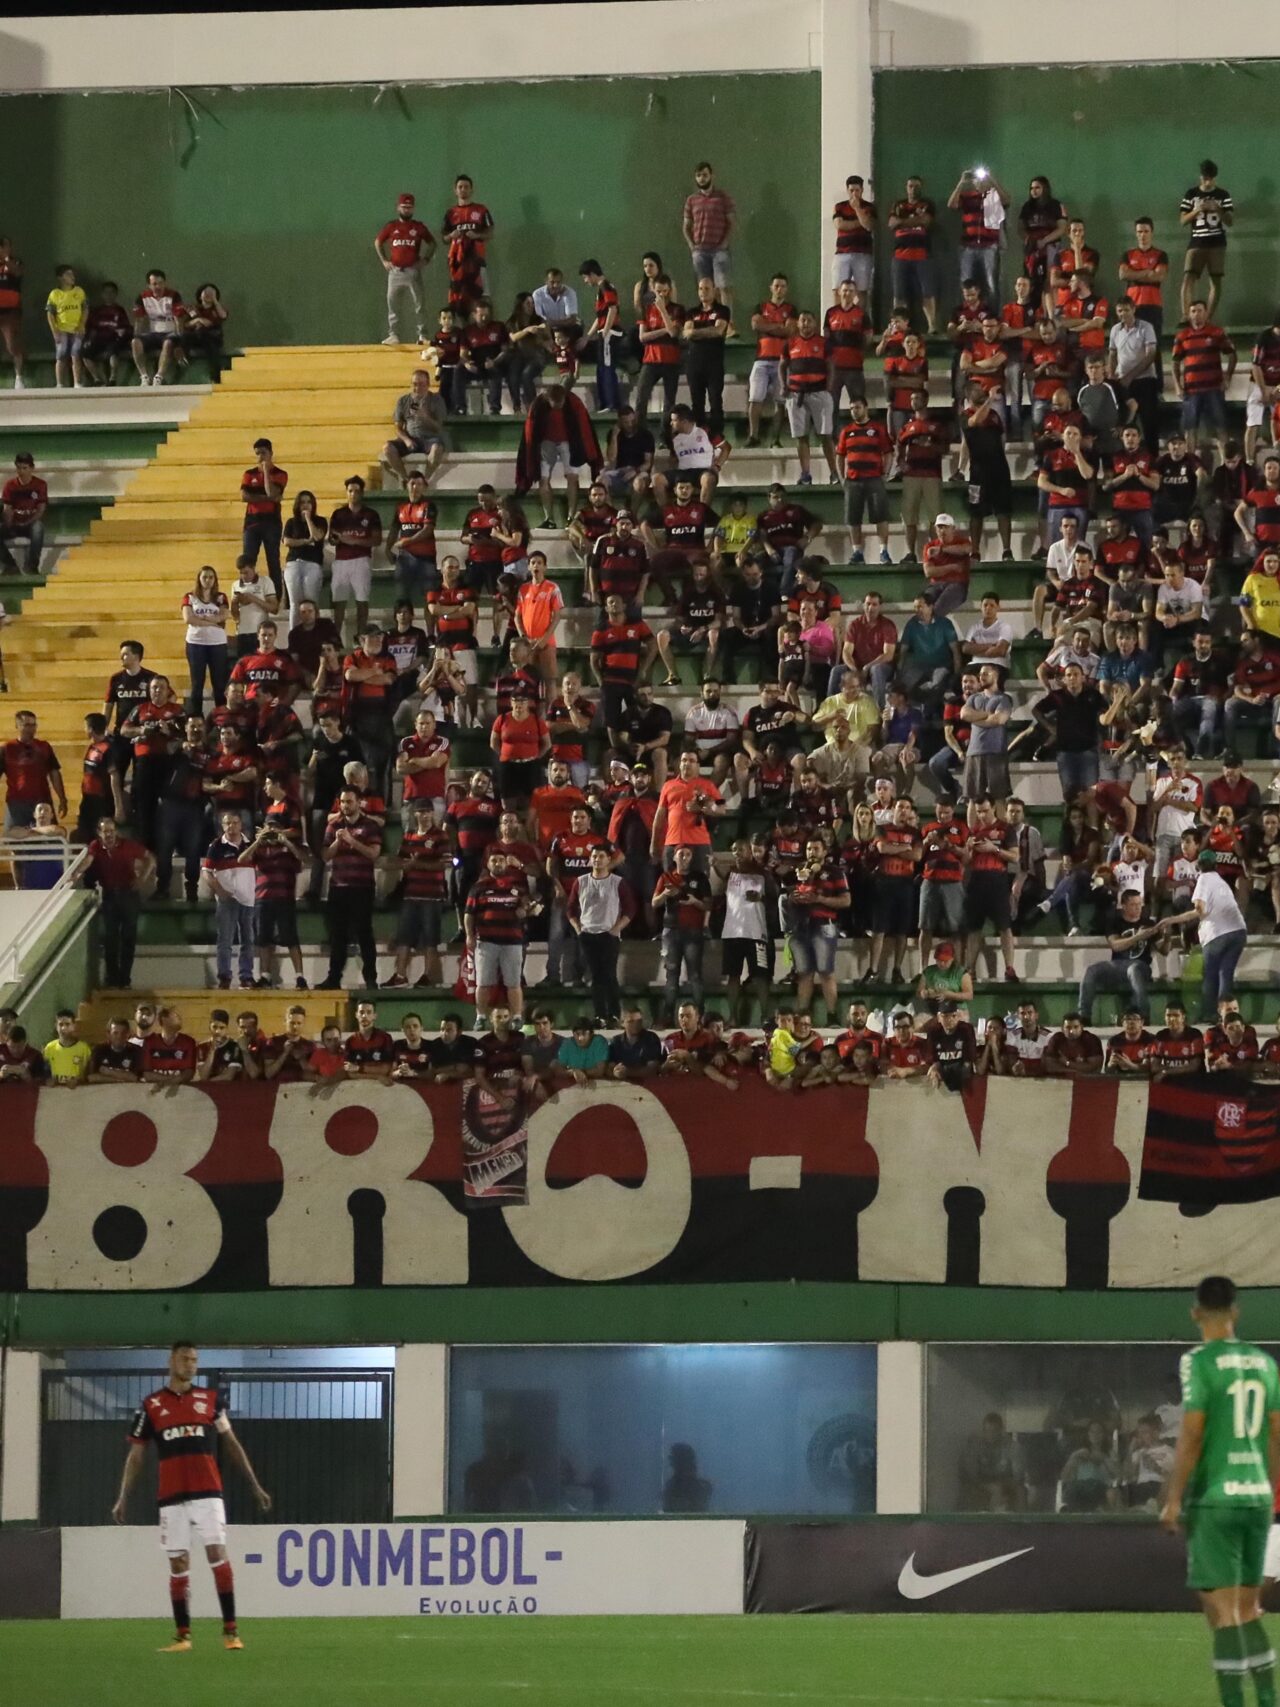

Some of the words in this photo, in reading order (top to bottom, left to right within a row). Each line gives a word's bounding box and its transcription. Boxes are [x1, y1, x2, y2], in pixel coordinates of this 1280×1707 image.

[679, 447, 705, 457] CAIXA
[671, 526, 696, 534] CAIXA
[248, 670, 279, 681] CAIXA
[117, 690, 147, 698] CAIXA
[755, 942, 768, 969] NIKE
[937, 1050, 963, 1060] AIXA
[1226, 1379, 1266, 1439] 10
[162, 1425, 205, 1441] CAIXA
